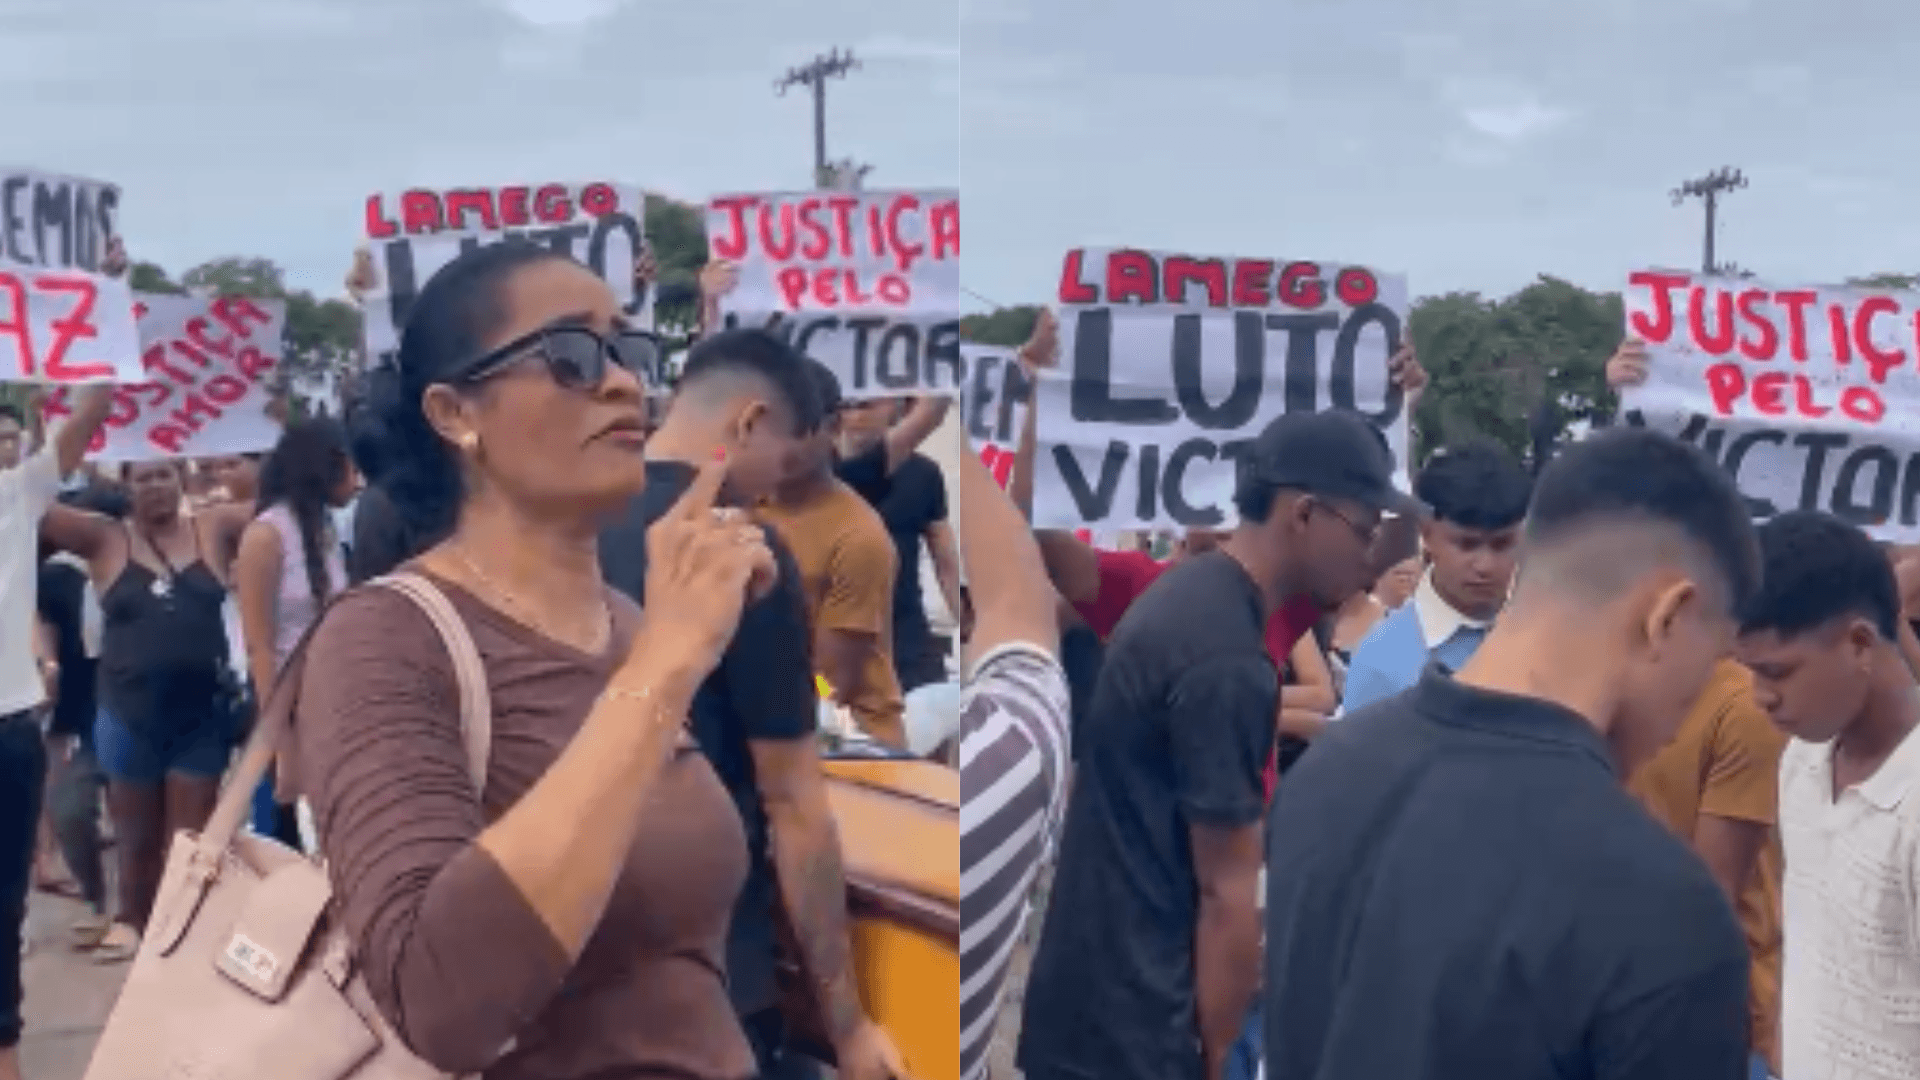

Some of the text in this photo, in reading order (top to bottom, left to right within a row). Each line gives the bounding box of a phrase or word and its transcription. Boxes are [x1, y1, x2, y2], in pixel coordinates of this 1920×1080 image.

[365, 183, 619, 239] LAMEGO
[711, 193, 960, 271] JUSTIÇA
[778, 268, 910, 310] PELO
[1059, 249, 1378, 308] LAMEGO
[724, 313, 960, 390] TOR
[1071, 302, 1403, 429] LUTO
[1628, 272, 1920, 384] JUSTIÇ
[86, 298, 271, 453] USTIÇA
[148, 345, 275, 453] AMOR
[1705, 362, 1886, 424] PELO
